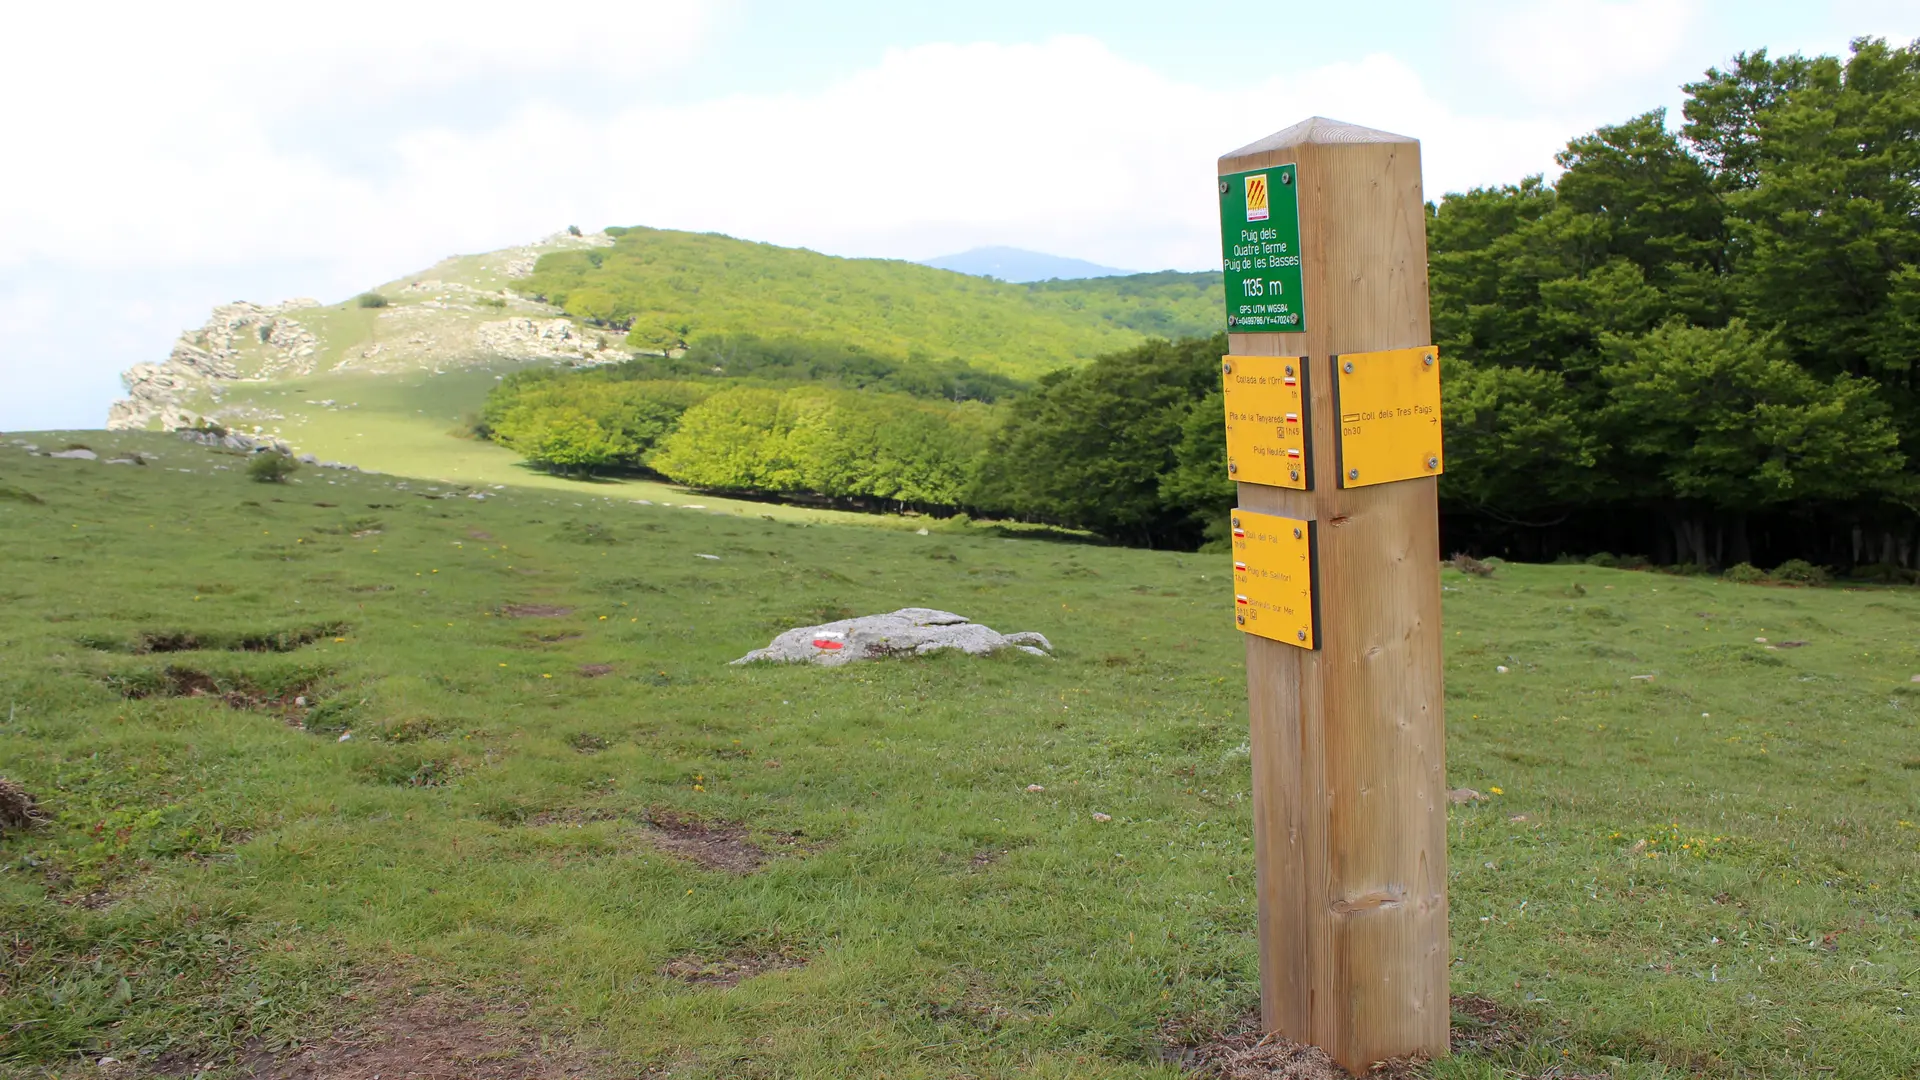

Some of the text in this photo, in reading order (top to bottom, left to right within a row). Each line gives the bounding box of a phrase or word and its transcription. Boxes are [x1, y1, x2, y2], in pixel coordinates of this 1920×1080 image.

[1241, 227, 1277, 243] Puig dels
[1233, 241, 1287, 257] Quatre Terme
[1224, 254, 1299, 272] Puig de les Basses
[1242, 277, 1283, 297] 1135 m
[1239, 303, 1288, 314] GPS UTM WGS84
[1235, 374, 1283, 385] Collada de l'Orri
[1229, 411, 1239, 421] Pla
[1240, 413, 1247, 421] de
[1248, 414, 1254, 422] la
[1361, 405, 1433, 421] Coll dels Tres Faigs
[1343, 426, 1361, 437] 0h30
[1253, 445, 1266, 456] Puig
[1268, 534, 1278, 544] Pal
[1247, 565, 1260, 578] Puig
[1260, 568, 1268, 578] de
[1283, 606, 1294, 616] Mer
